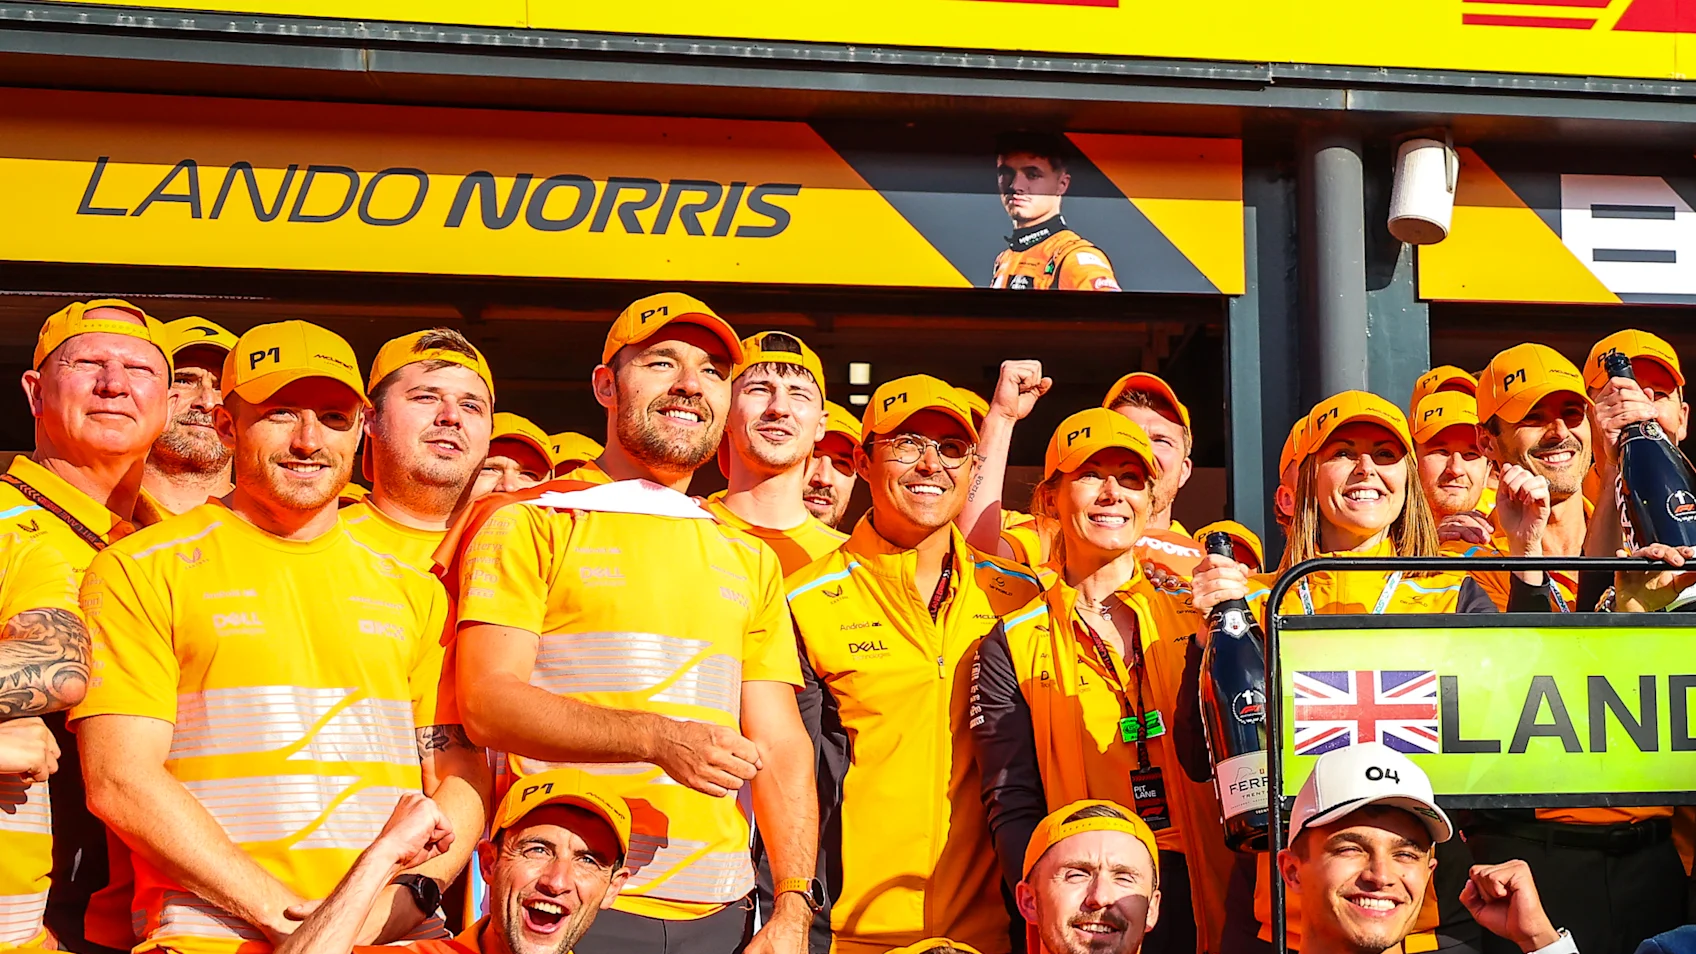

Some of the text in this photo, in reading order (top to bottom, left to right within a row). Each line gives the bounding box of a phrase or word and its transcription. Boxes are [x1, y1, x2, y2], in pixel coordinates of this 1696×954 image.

[75, 156, 803, 239] LANDO NORRIS
[640, 305, 668, 325] P1
[249, 347, 281, 370] P1
[1422, 374, 1439, 389] P1
[1503, 368, 1526, 392] P1
[882, 391, 908, 412] P1
[1317, 407, 1338, 430] P1
[1423, 406, 1443, 421] P1
[1066, 427, 1091, 447] P1
[1135, 535, 1201, 558] VOORT
[212, 612, 264, 629] DELL
[840, 621, 870, 632] Android
[848, 640, 888, 653] DELL
[520, 782, 553, 802] P1
[1134, 785, 1147, 793] PIT
[1135, 790, 1157, 799] LANE
